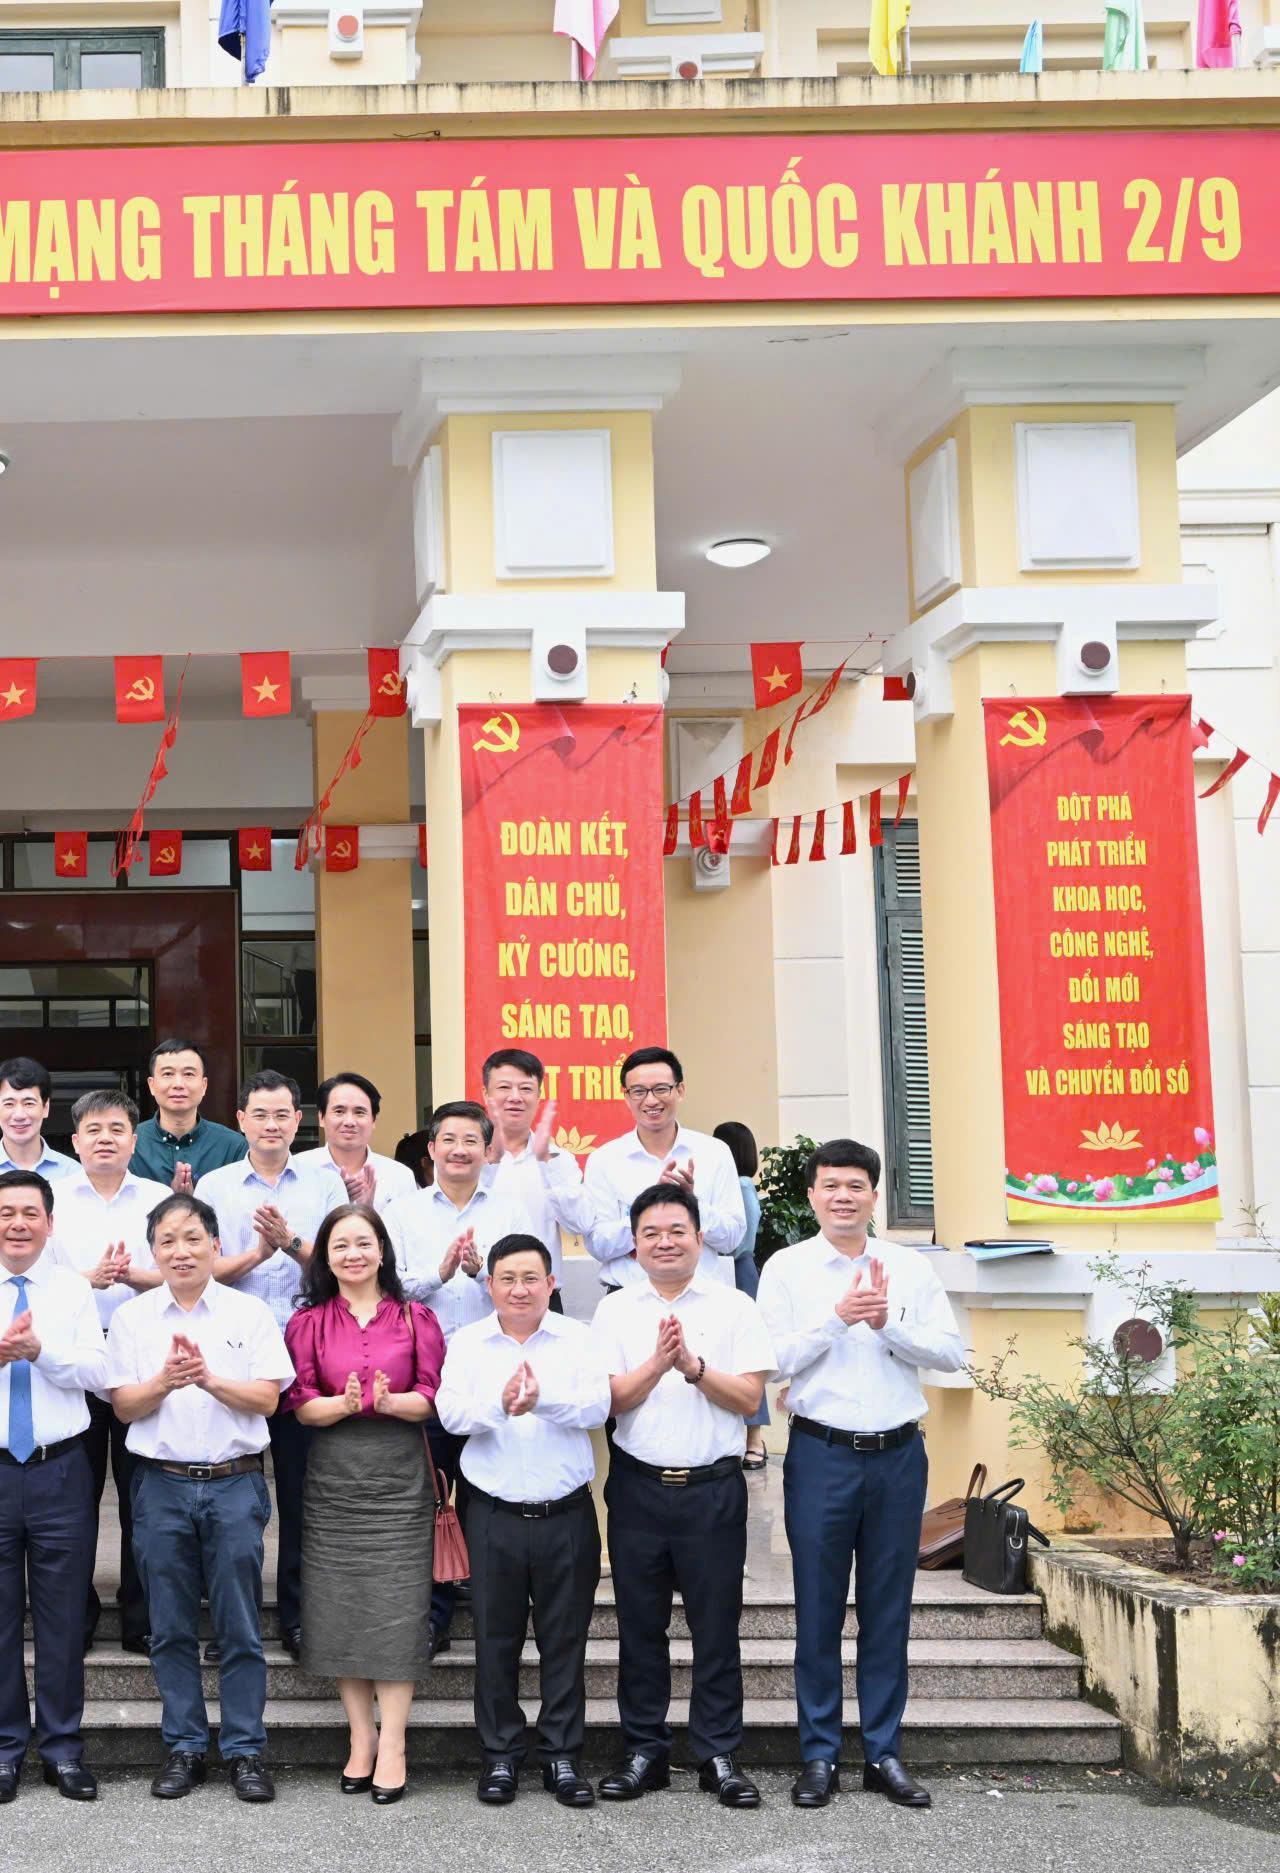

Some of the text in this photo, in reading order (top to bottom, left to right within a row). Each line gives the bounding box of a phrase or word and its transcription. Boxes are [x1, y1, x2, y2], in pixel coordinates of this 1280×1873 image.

[183, 180, 395, 278] THÁNG
[416, 176, 554, 272] TÁM
[574, 173, 662, 269] VÀ
[681, 156, 859, 278] QUỐC
[881, 168, 1102, 266] KHÁNH
[1124, 177, 1241, 263] 2/9
[1057, 792, 1132, 825] ĐỘT PHÁ
[500, 811, 628, 859] ĐOÀN KẾT,
[1047, 832, 1146, 866] PHÁT TRIỂN
[505, 874, 626, 920] DÂN CHỦ,
[1053, 885, 1146, 915] KHOA HỌC,
[499, 934, 635, 981] KỶ CƯƠNG,
[1050, 927, 1153, 960] CÔNG NGHỆ,
[1069, 968, 1139, 1003] ĐỔI MỚI
[502, 998, 633, 1045] SÁNG TẠO,
[1063, 1020, 1149, 1052] SÁNG TẠO
[568, 1053, 627, 1100] TRIỂ
[1026, 1060, 1189, 1095] VÀ CHUYỂN ĐỔI SỐ
